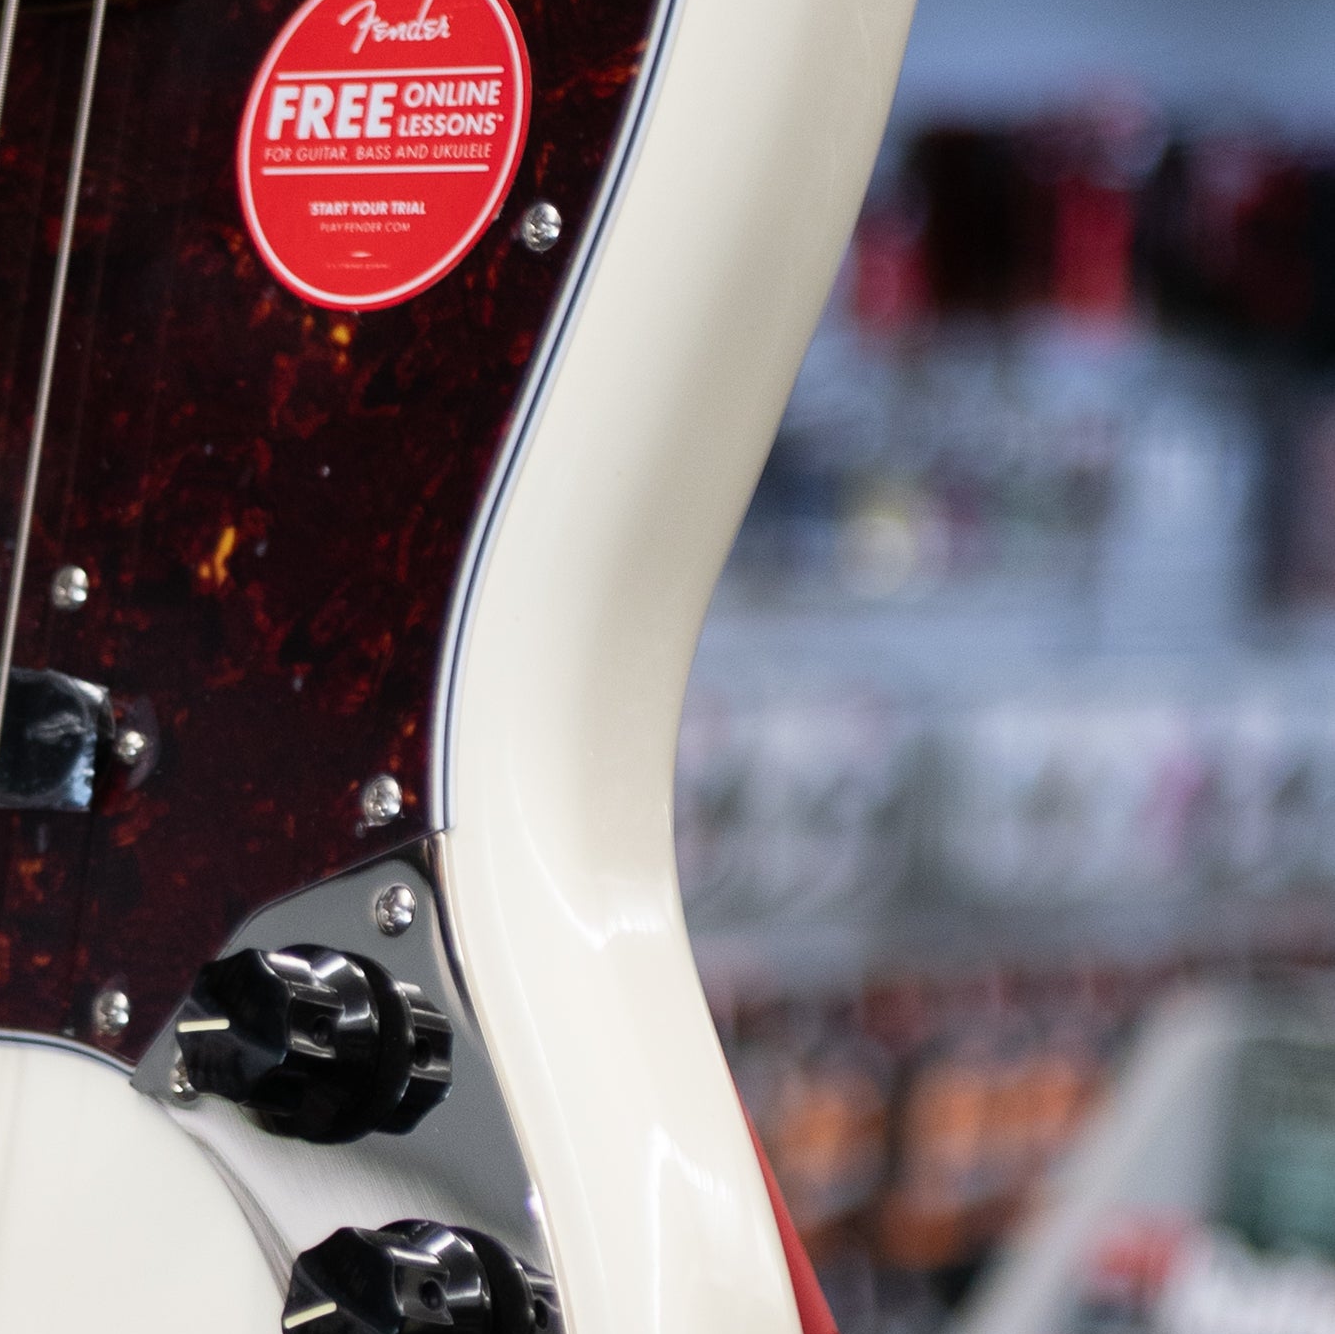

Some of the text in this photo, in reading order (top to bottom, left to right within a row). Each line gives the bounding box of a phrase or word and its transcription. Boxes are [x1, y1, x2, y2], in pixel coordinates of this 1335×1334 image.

[267, 80, 502, 140] FREE ONLINE
[264, 146, 293, 163] FOR
[355, 144, 391, 161] BASS
[396, 143, 429, 159] AND
[432, 142, 492, 159] UKULELE
[309, 200, 426, 216] START YOUR TRIAL
